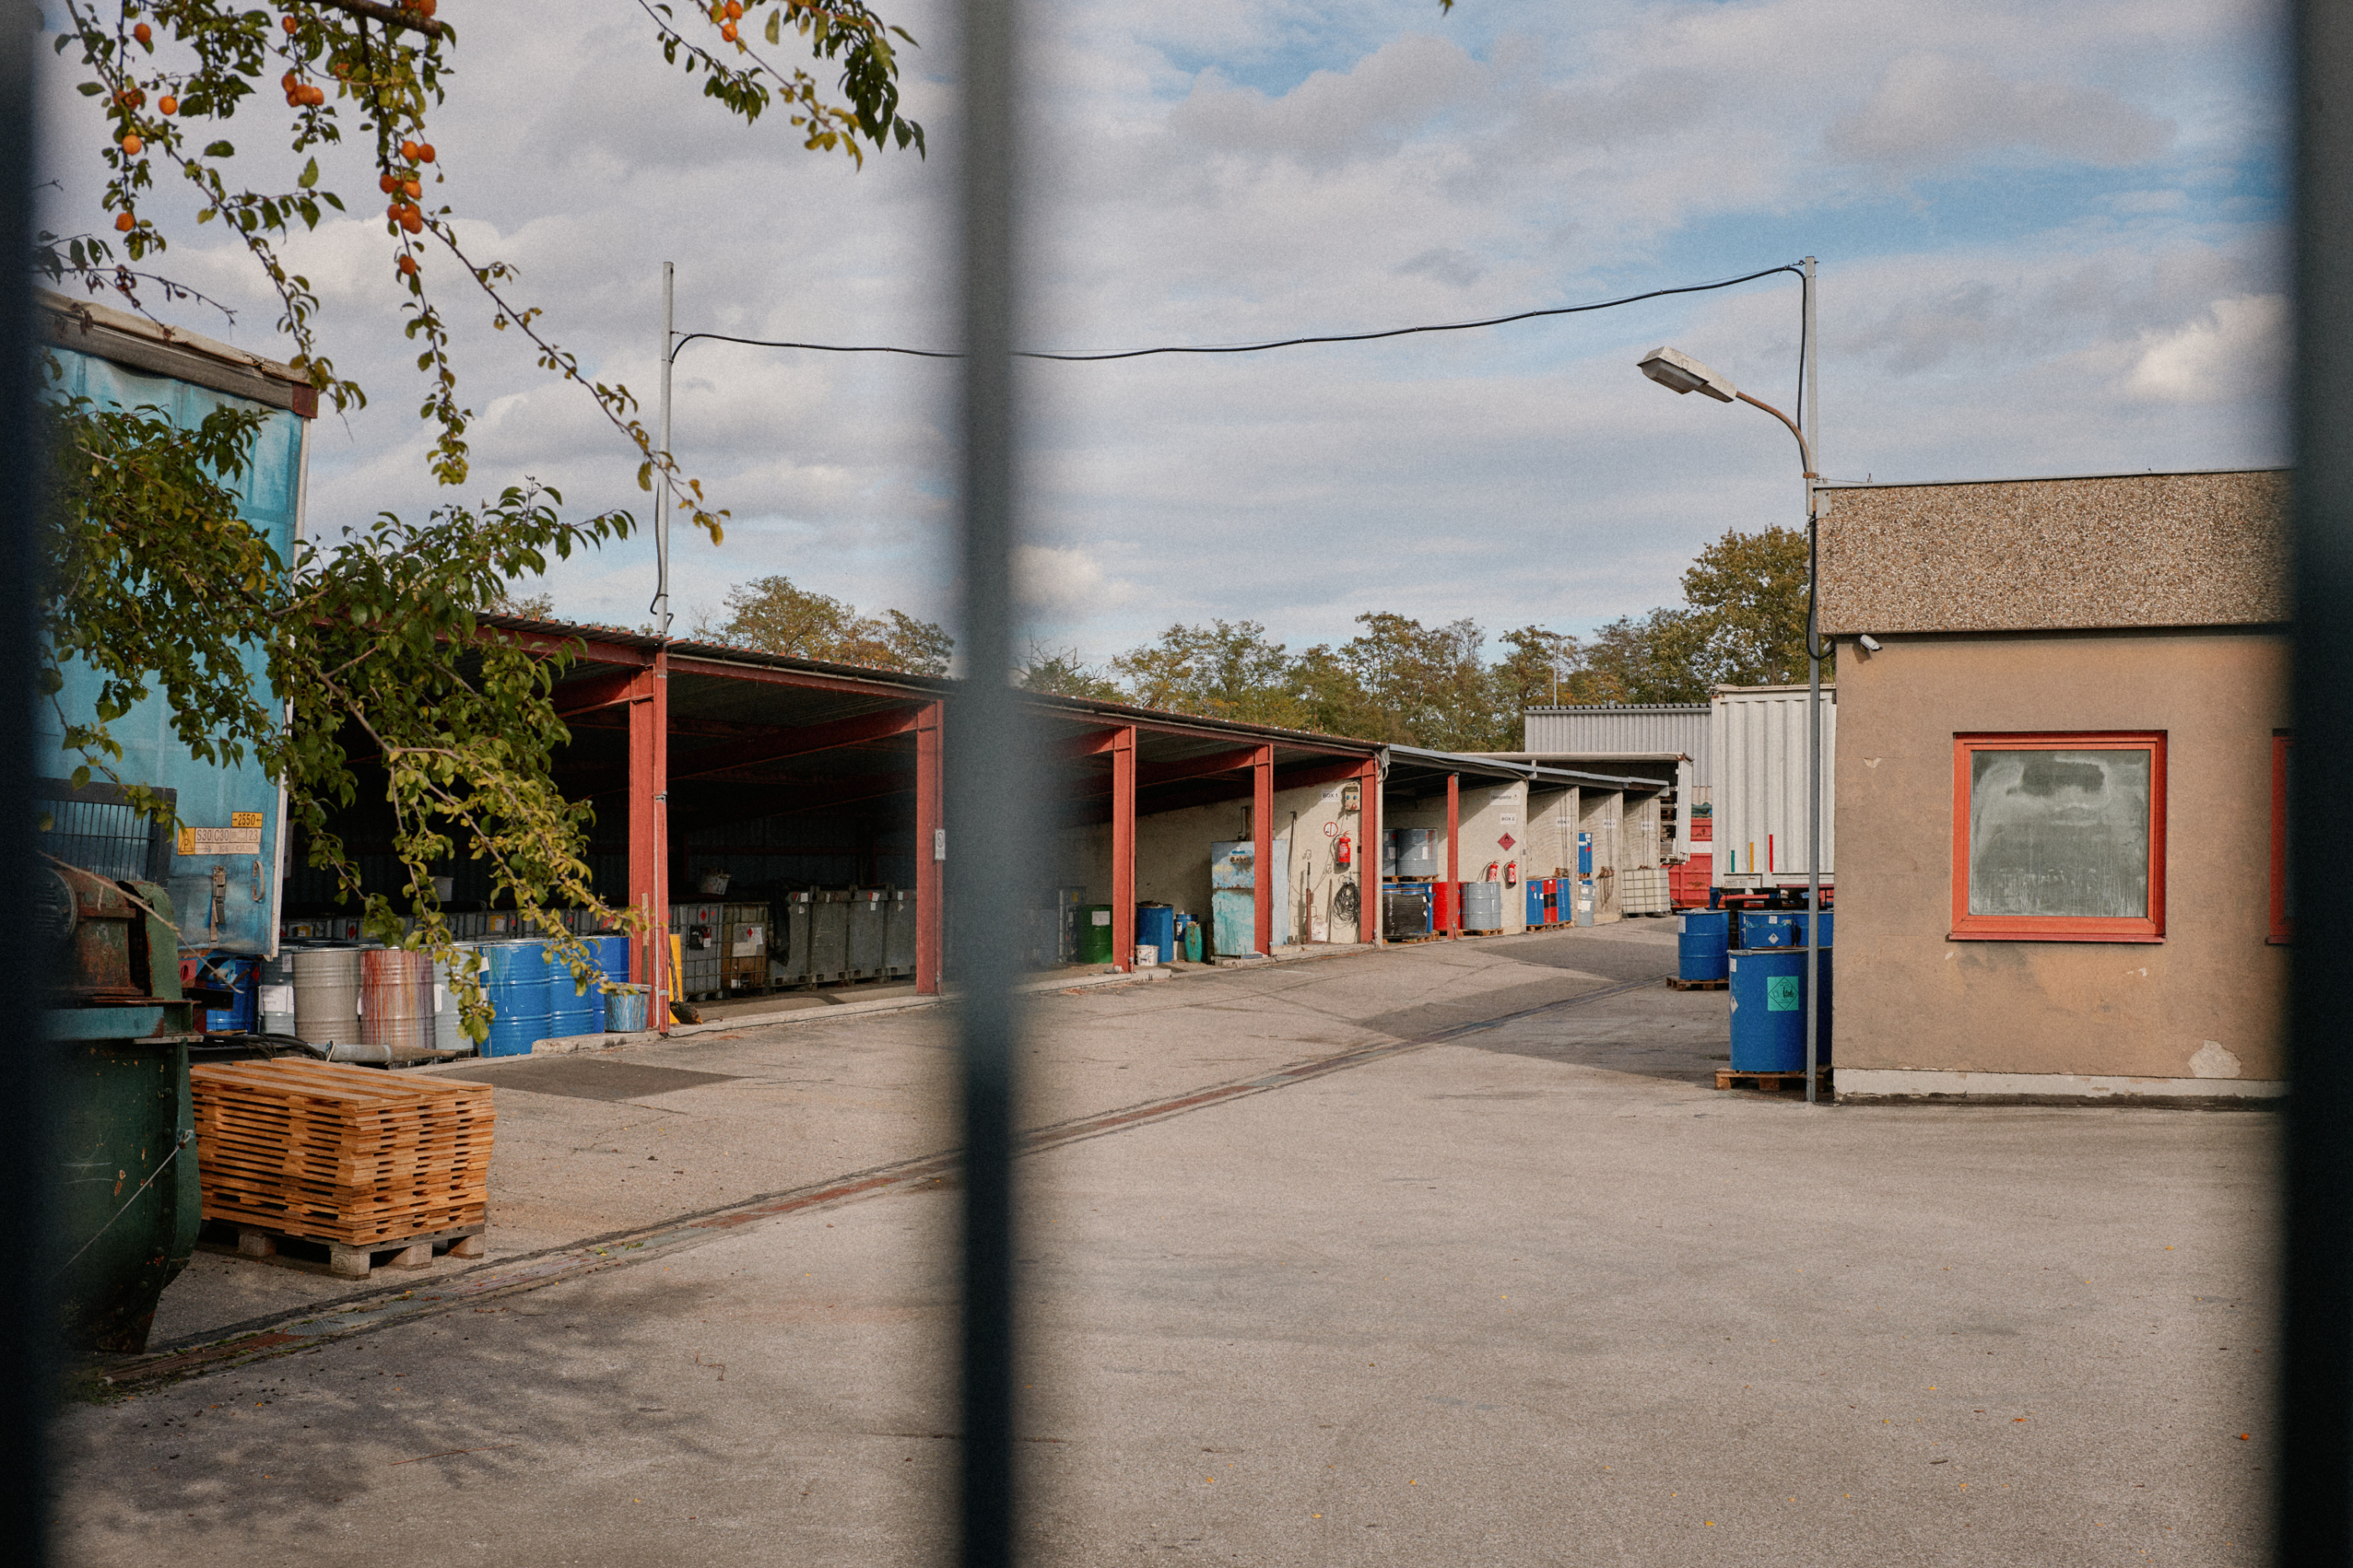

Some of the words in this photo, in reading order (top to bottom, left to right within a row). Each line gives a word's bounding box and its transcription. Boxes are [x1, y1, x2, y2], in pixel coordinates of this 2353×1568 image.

[238, 813, 255, 825] 2550
[197, 829, 212, 840] S30
[214, 829, 229, 841] C30
[249, 829, 258, 840] 23
